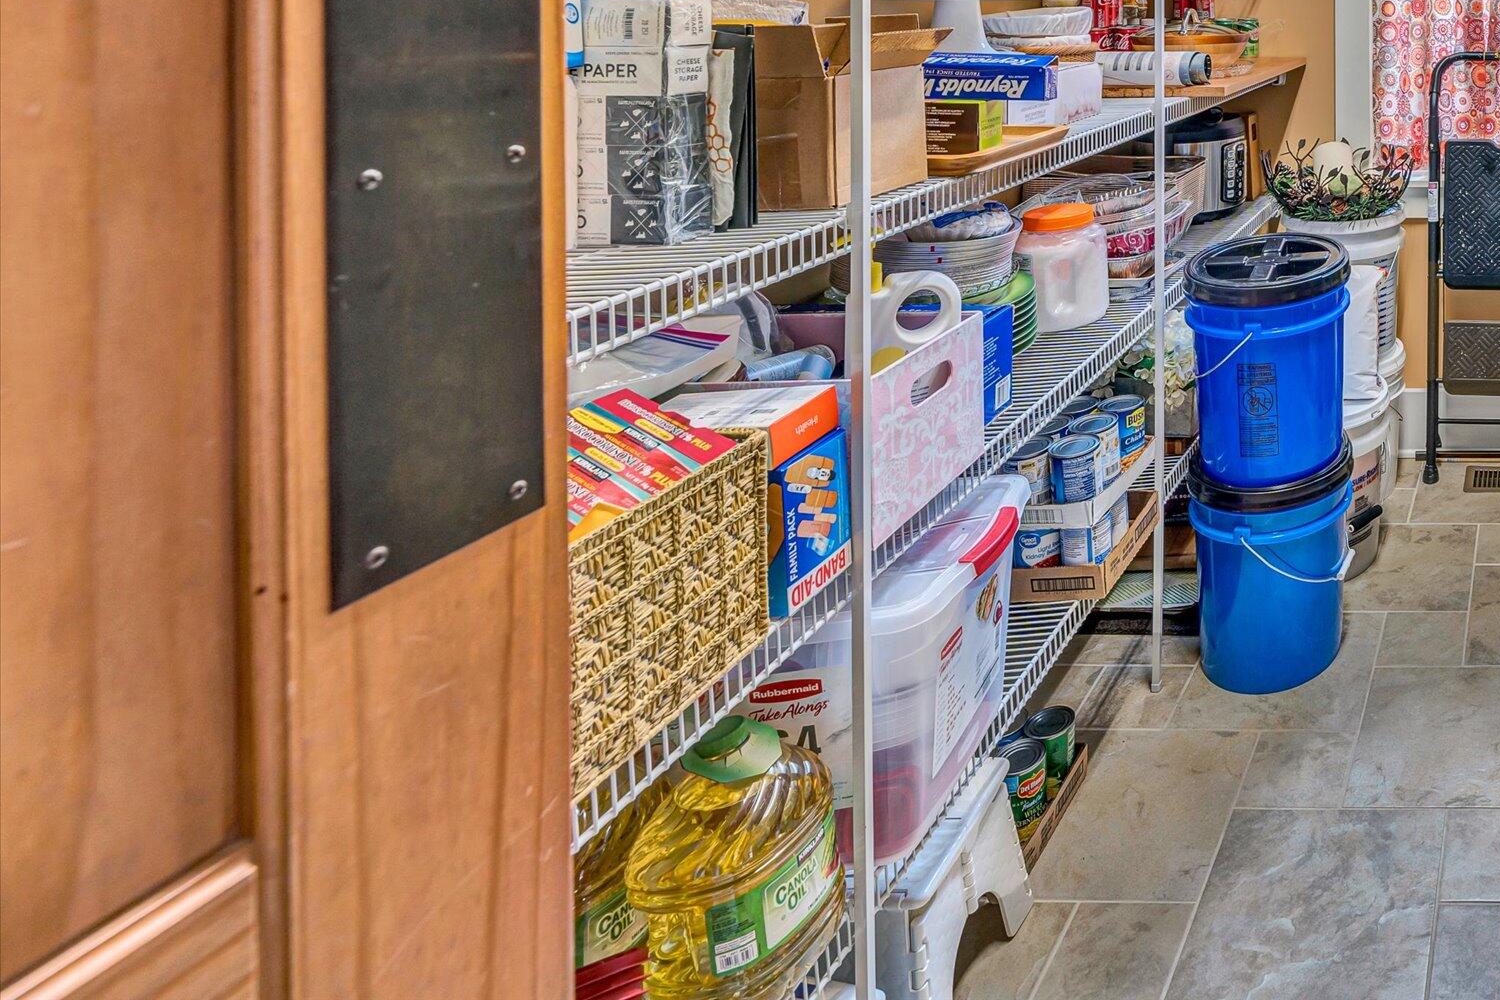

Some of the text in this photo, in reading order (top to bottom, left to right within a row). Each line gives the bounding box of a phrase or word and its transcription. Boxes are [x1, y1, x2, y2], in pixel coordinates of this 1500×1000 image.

[583, 63, 637, 78] PAPER
[674, 66, 703, 74] STORAGE
[676, 58, 701, 66] CHEESE
[679, 74, 699, 82] PAPER
[936, 75, 1030, 99] Reynolds
[624, 427, 659, 451] KIRKLAND
[573, 456, 611, 480] KIRKLAND
[787, 507, 798, 581] PACK FAMILY
[752, 683, 819, 700] Rubbermaid
[774, 858, 818, 905] CANOLA
[787, 887, 807, 911] OIL
[610, 913, 636, 941] OIL
